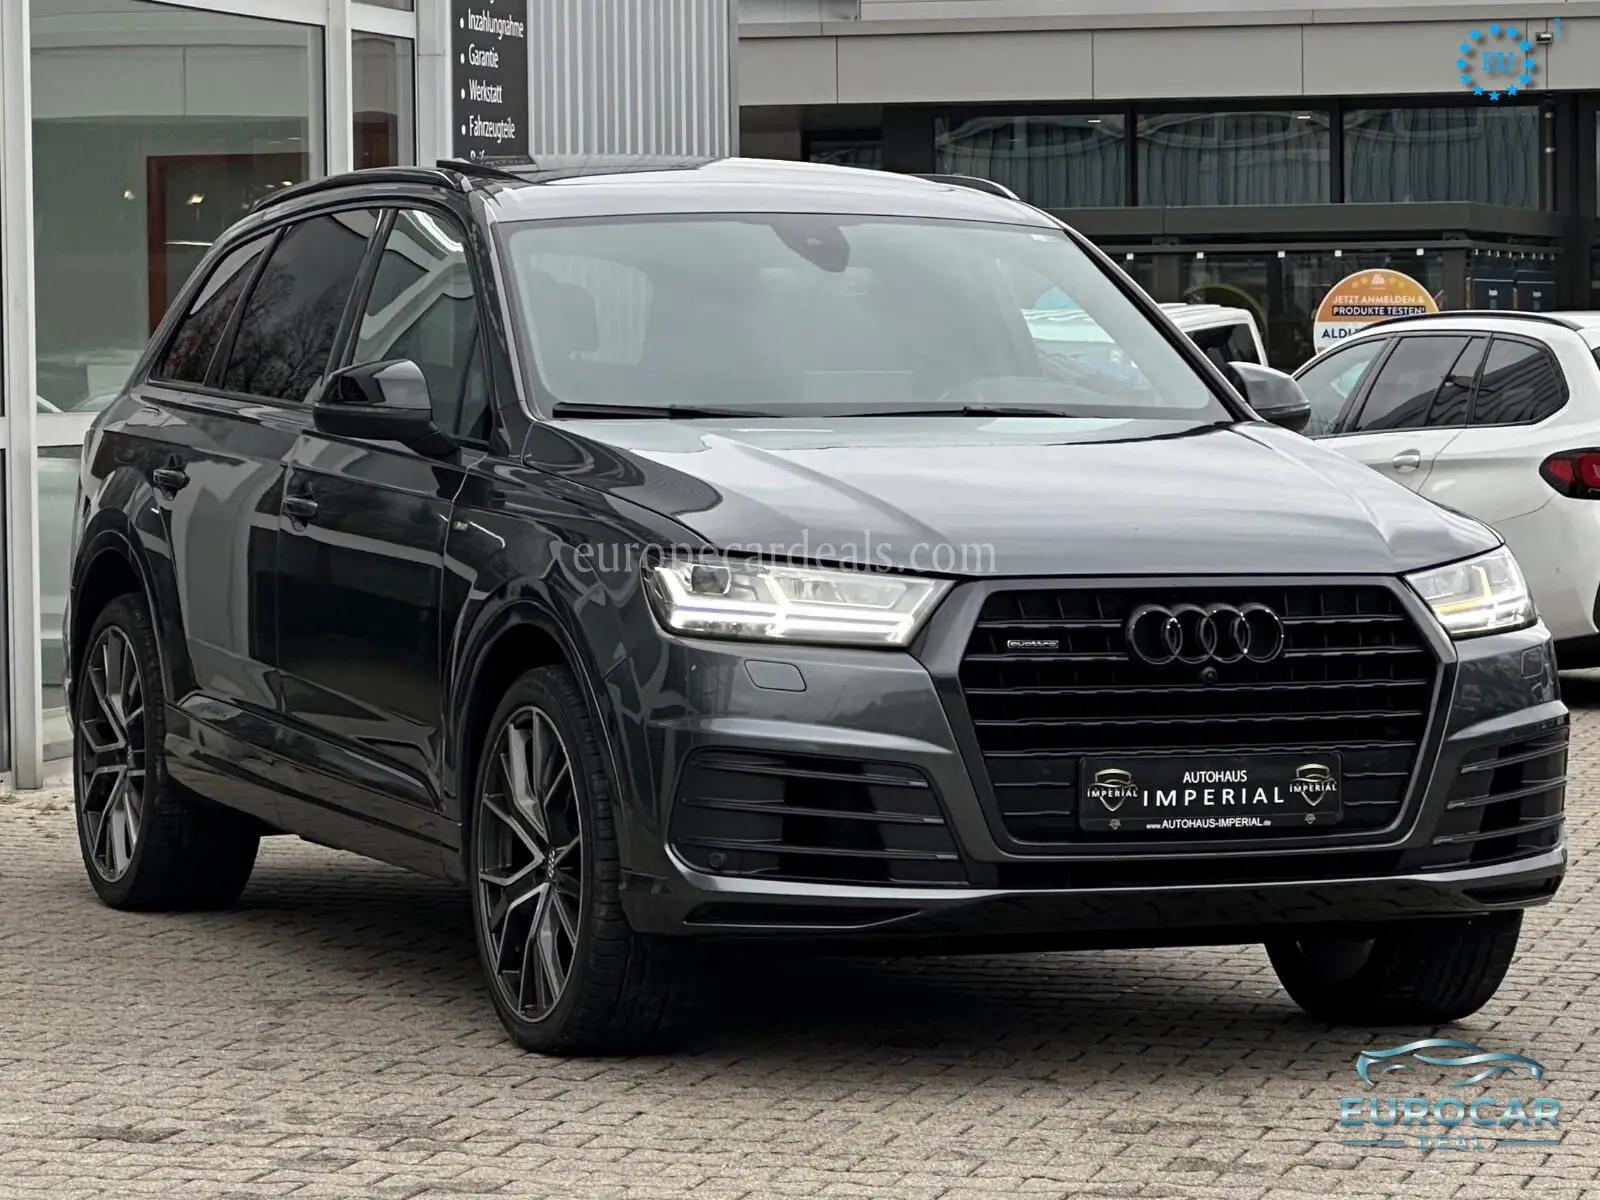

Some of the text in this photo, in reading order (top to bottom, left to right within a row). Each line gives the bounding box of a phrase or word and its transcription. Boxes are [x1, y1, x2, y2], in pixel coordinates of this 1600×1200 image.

[468, 8, 524, 40] Inzahlungnahme
[468, 43, 499, 69] Garantie
[468, 79, 503, 104] Werkstatt
[469, 114, 515, 143] Fahrzeugteile
[1333, 295, 1360, 304] JETZT
[1362, 295, 1415, 304] ANMELDEN
[1333, 306, 1385, 315] PRODUKTE
[1182, 770, 1247, 784] AUTOHAUS
[1087, 789, 1138, 798] IMPERIAL
[1289, 783, 1337, 793] IMPERIAL
[1143, 786, 1284, 806] IMPERIAL
[1146, 817, 1271, 829] www.AUTOHAUS-IMPERIAL.de
